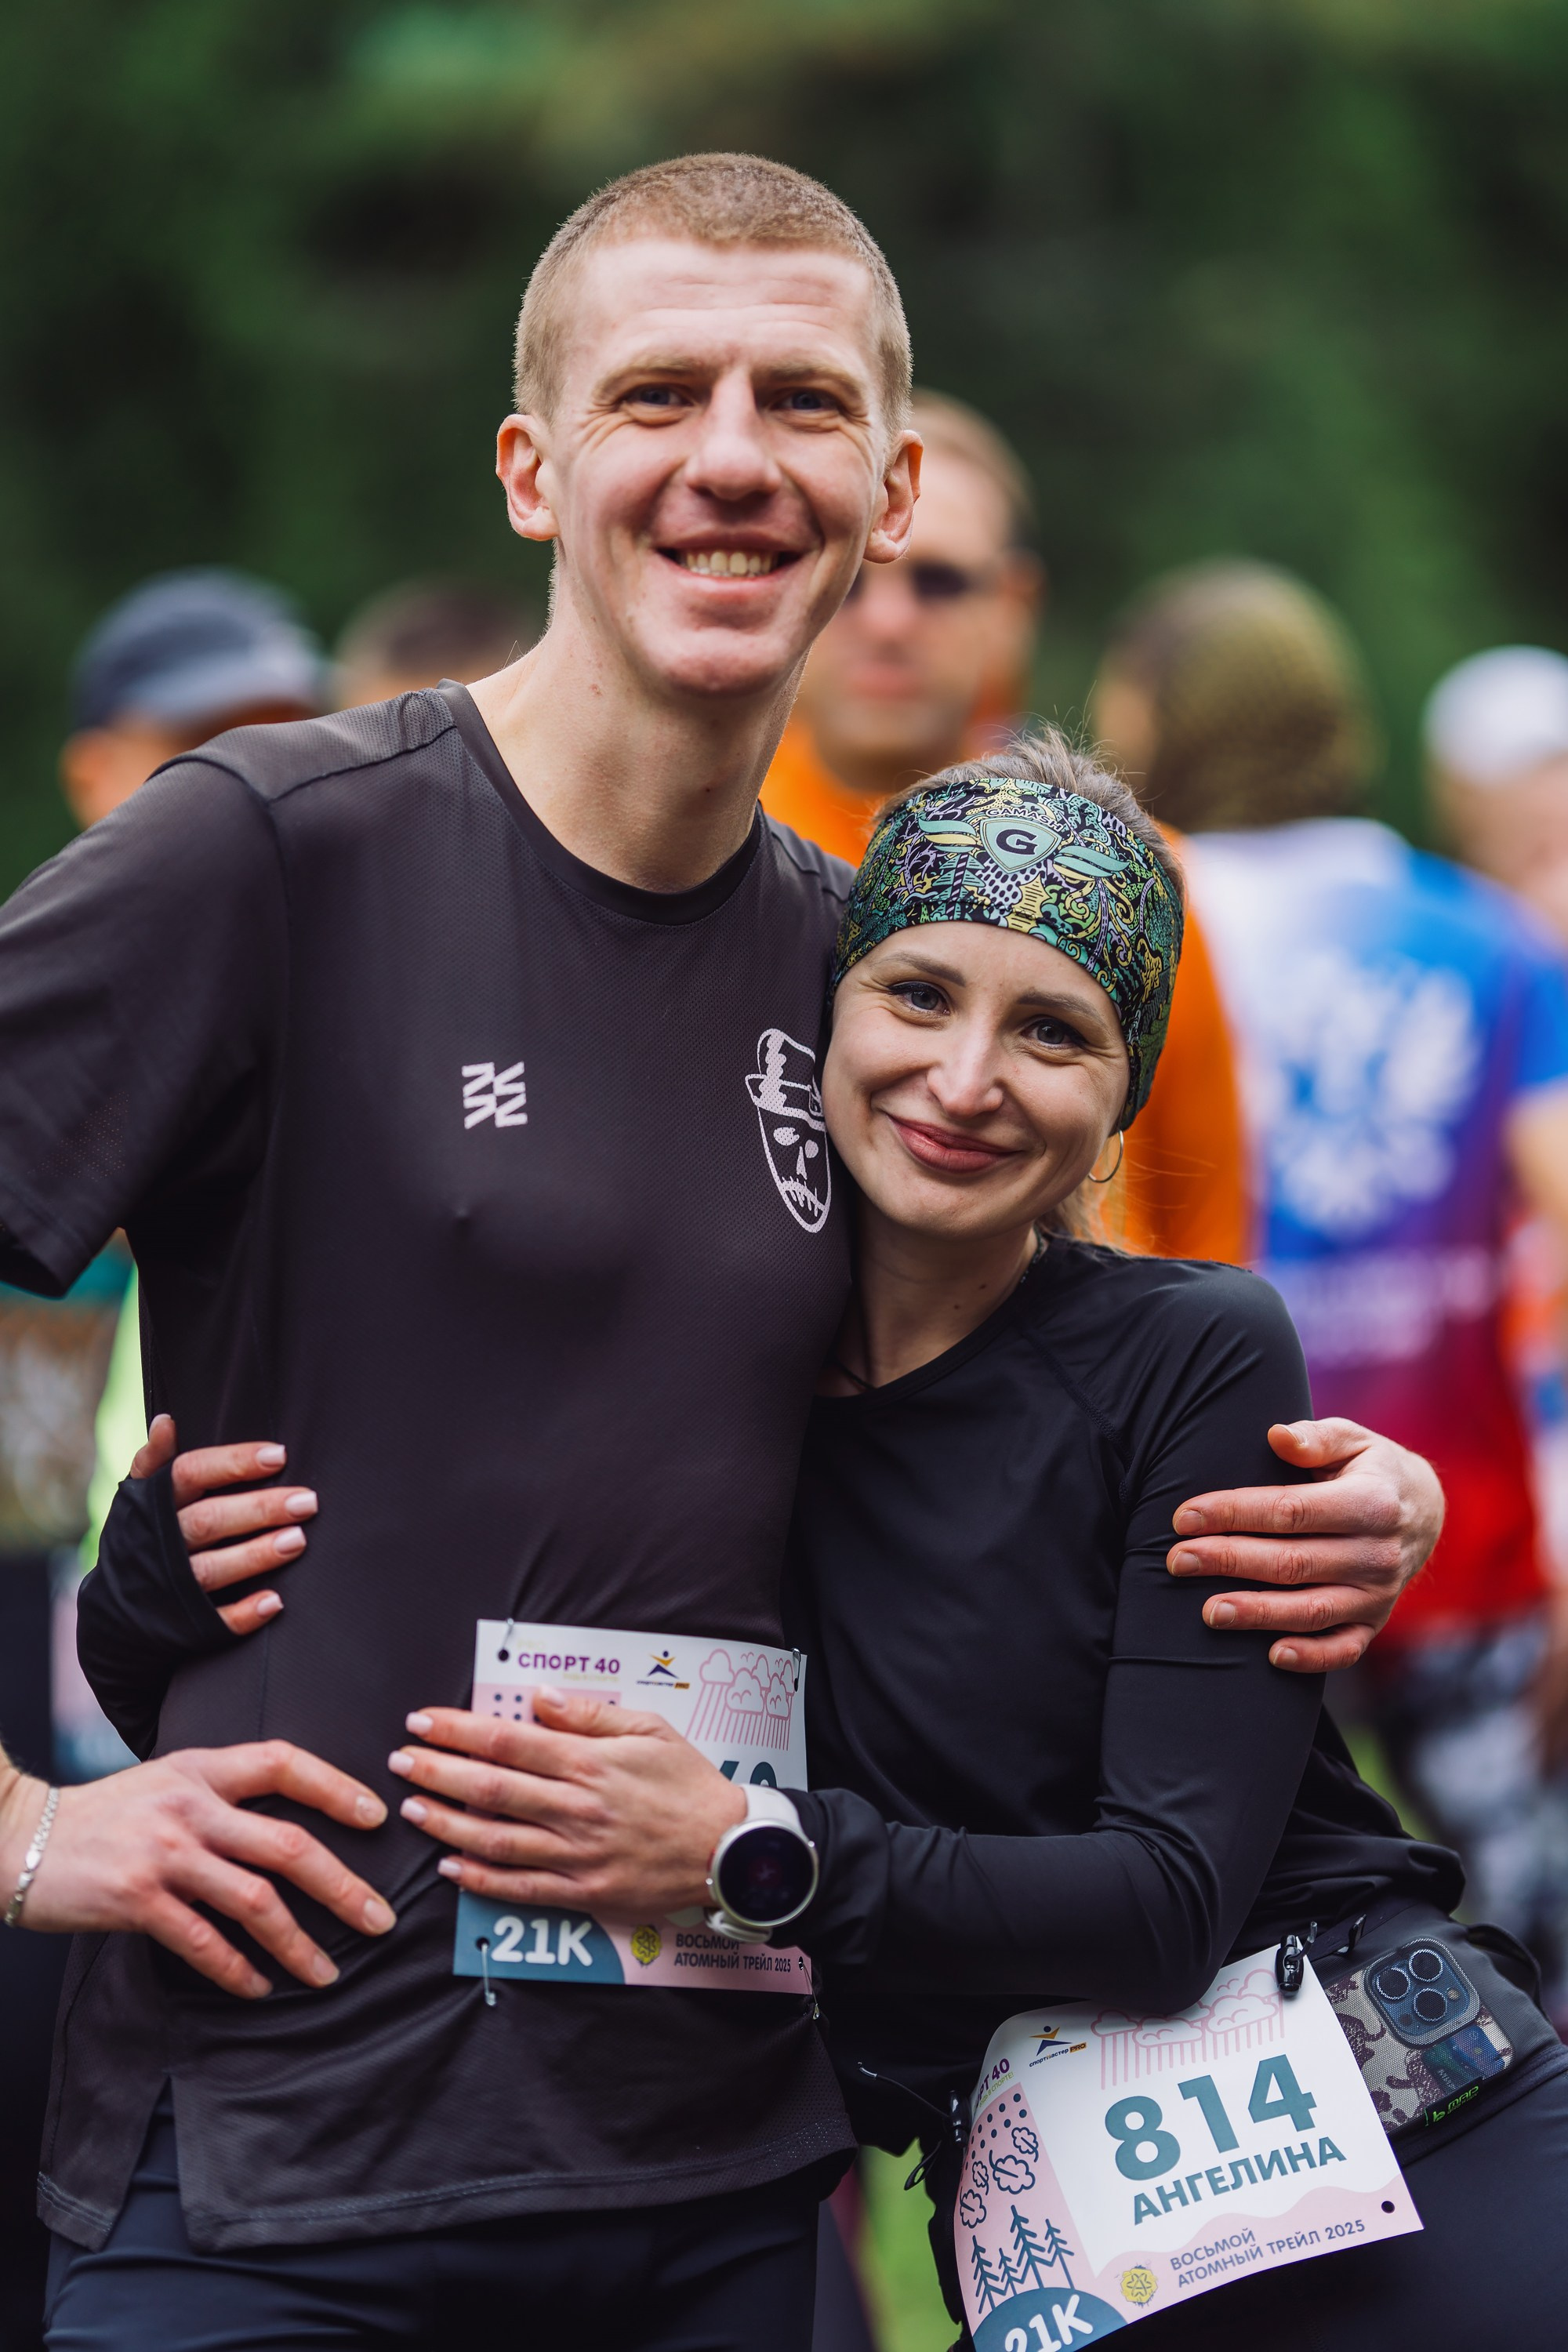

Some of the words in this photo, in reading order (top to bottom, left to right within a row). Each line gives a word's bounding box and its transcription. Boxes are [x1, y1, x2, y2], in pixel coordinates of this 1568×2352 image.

[987, 808, 1062, 831] GAMASH
[996, 829, 1038, 855] G
[518, 1653, 590, 1672] СПОРТ
[594, 1658, 620, 1674] 40
[674, 1951, 740, 1969] АТОМНЫЙ
[743, 1954, 772, 1971] ТРЕЙЛ
[775, 1958, 791, 1973] 2025
[1070, 2042, 1087, 2053] PRO
[992, 2058, 1010, 2081] 40
[1105, 2054, 1317, 2181] 814
[1134, 2136, 1347, 2226] АНГЕЛИНА
[1170, 2227, 1256, 2270] ВОСЬМОЙ
[1178, 2244, 1263, 2288] АТОМНЫЙ
[1266, 2230, 1321, 2255] ТРЕЙЛ
[1325, 2219, 1365, 2240] 2025
